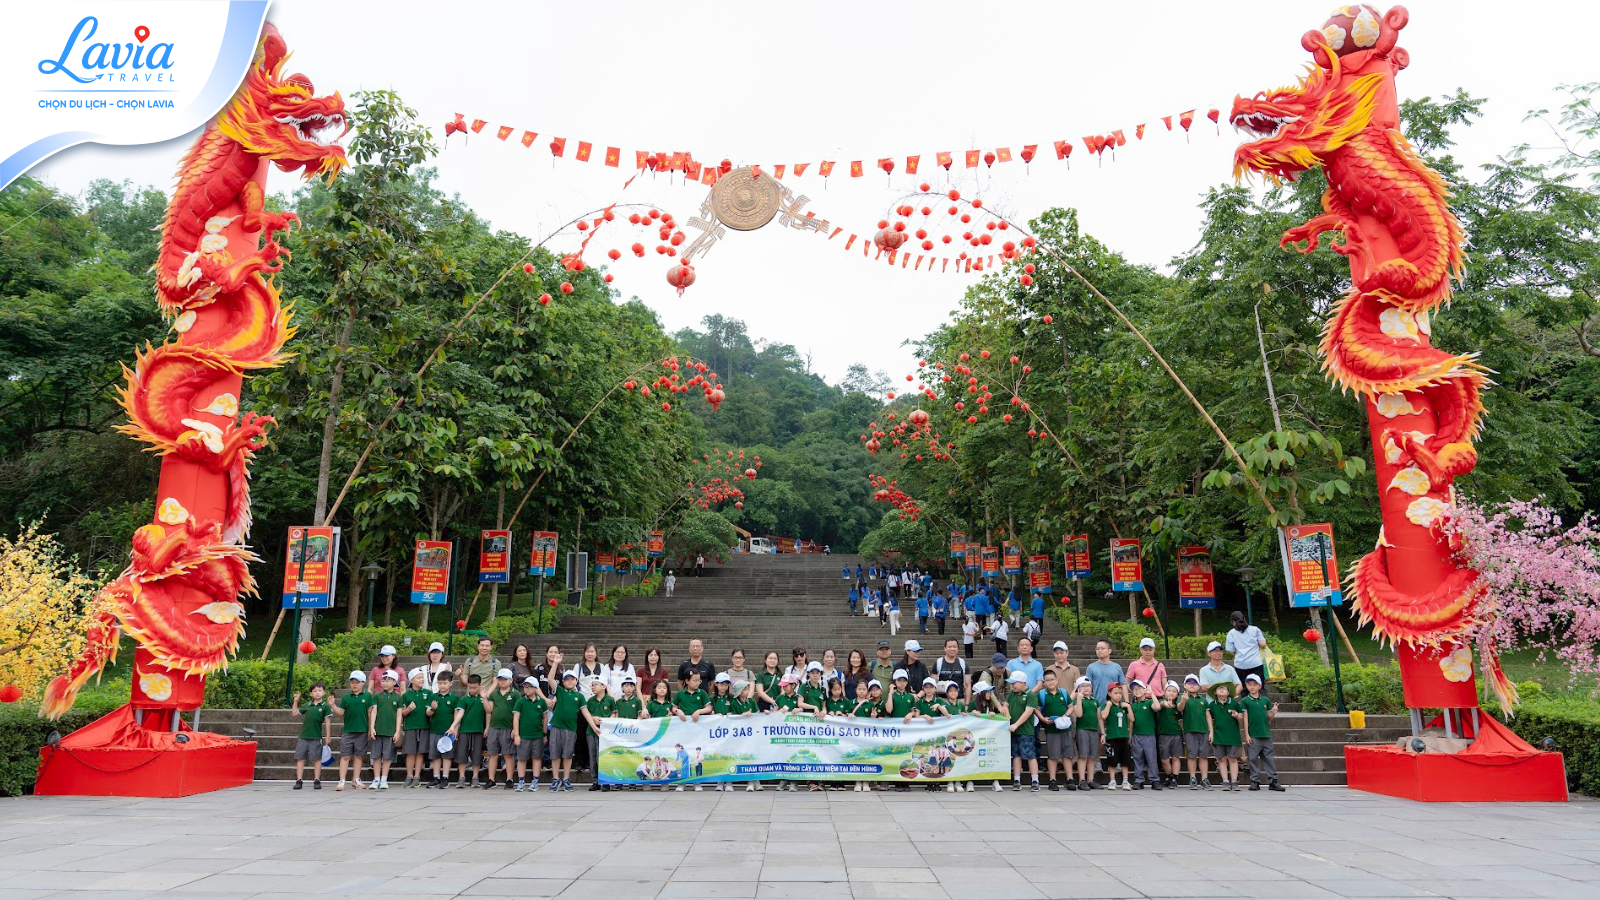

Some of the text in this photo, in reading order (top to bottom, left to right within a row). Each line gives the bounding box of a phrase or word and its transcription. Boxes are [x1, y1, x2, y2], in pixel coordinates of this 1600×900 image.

[609, 722, 640, 737] Lavia
[709, 726, 729, 738] LỚP
[733, 726, 753, 737] 3A8
[763, 724, 806, 736] TRƯỜNG
[809, 725, 835, 737] NGÔI
[839, 727, 860, 737] SAO
[864, 727, 879, 738] HÀ
[883, 727, 901, 740] NỘI
